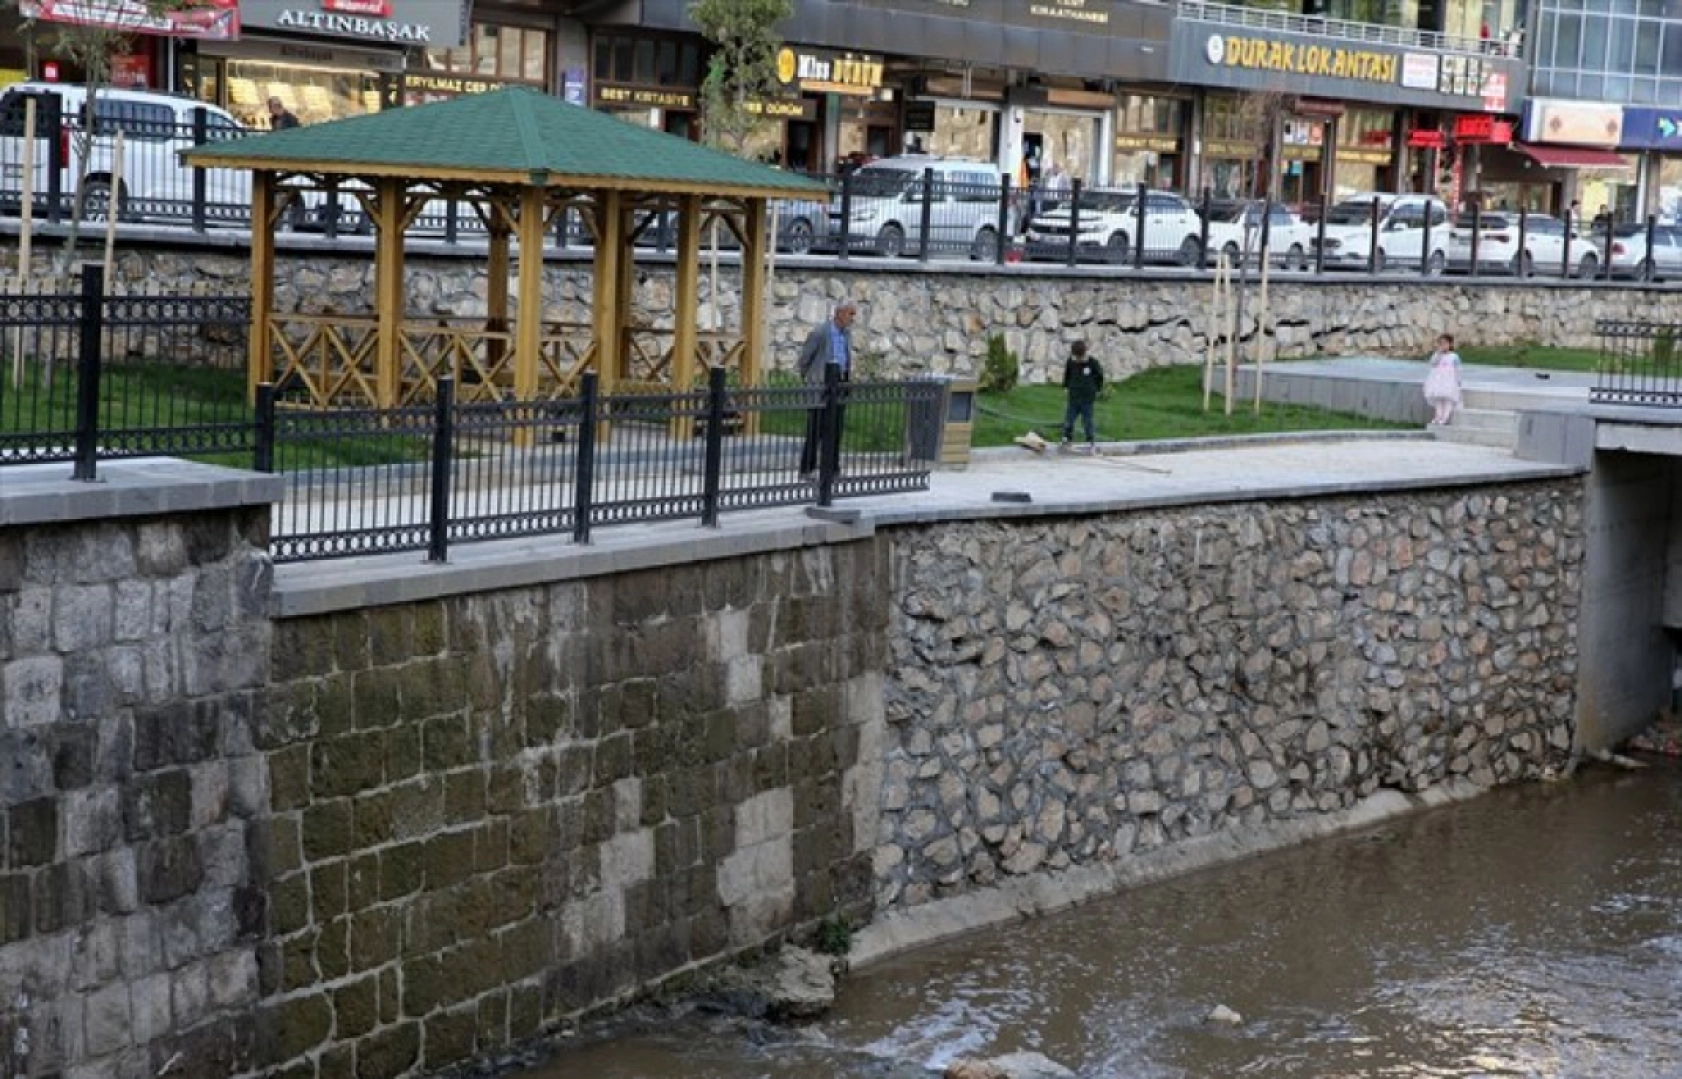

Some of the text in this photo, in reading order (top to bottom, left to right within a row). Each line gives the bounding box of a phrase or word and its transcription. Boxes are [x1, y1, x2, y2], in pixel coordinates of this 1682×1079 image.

[277, 9, 430, 42] ALTINBAŞAK
[1226, 36, 1294, 70] DURAK
[1297, 45, 1397, 83] LOKANTASI
